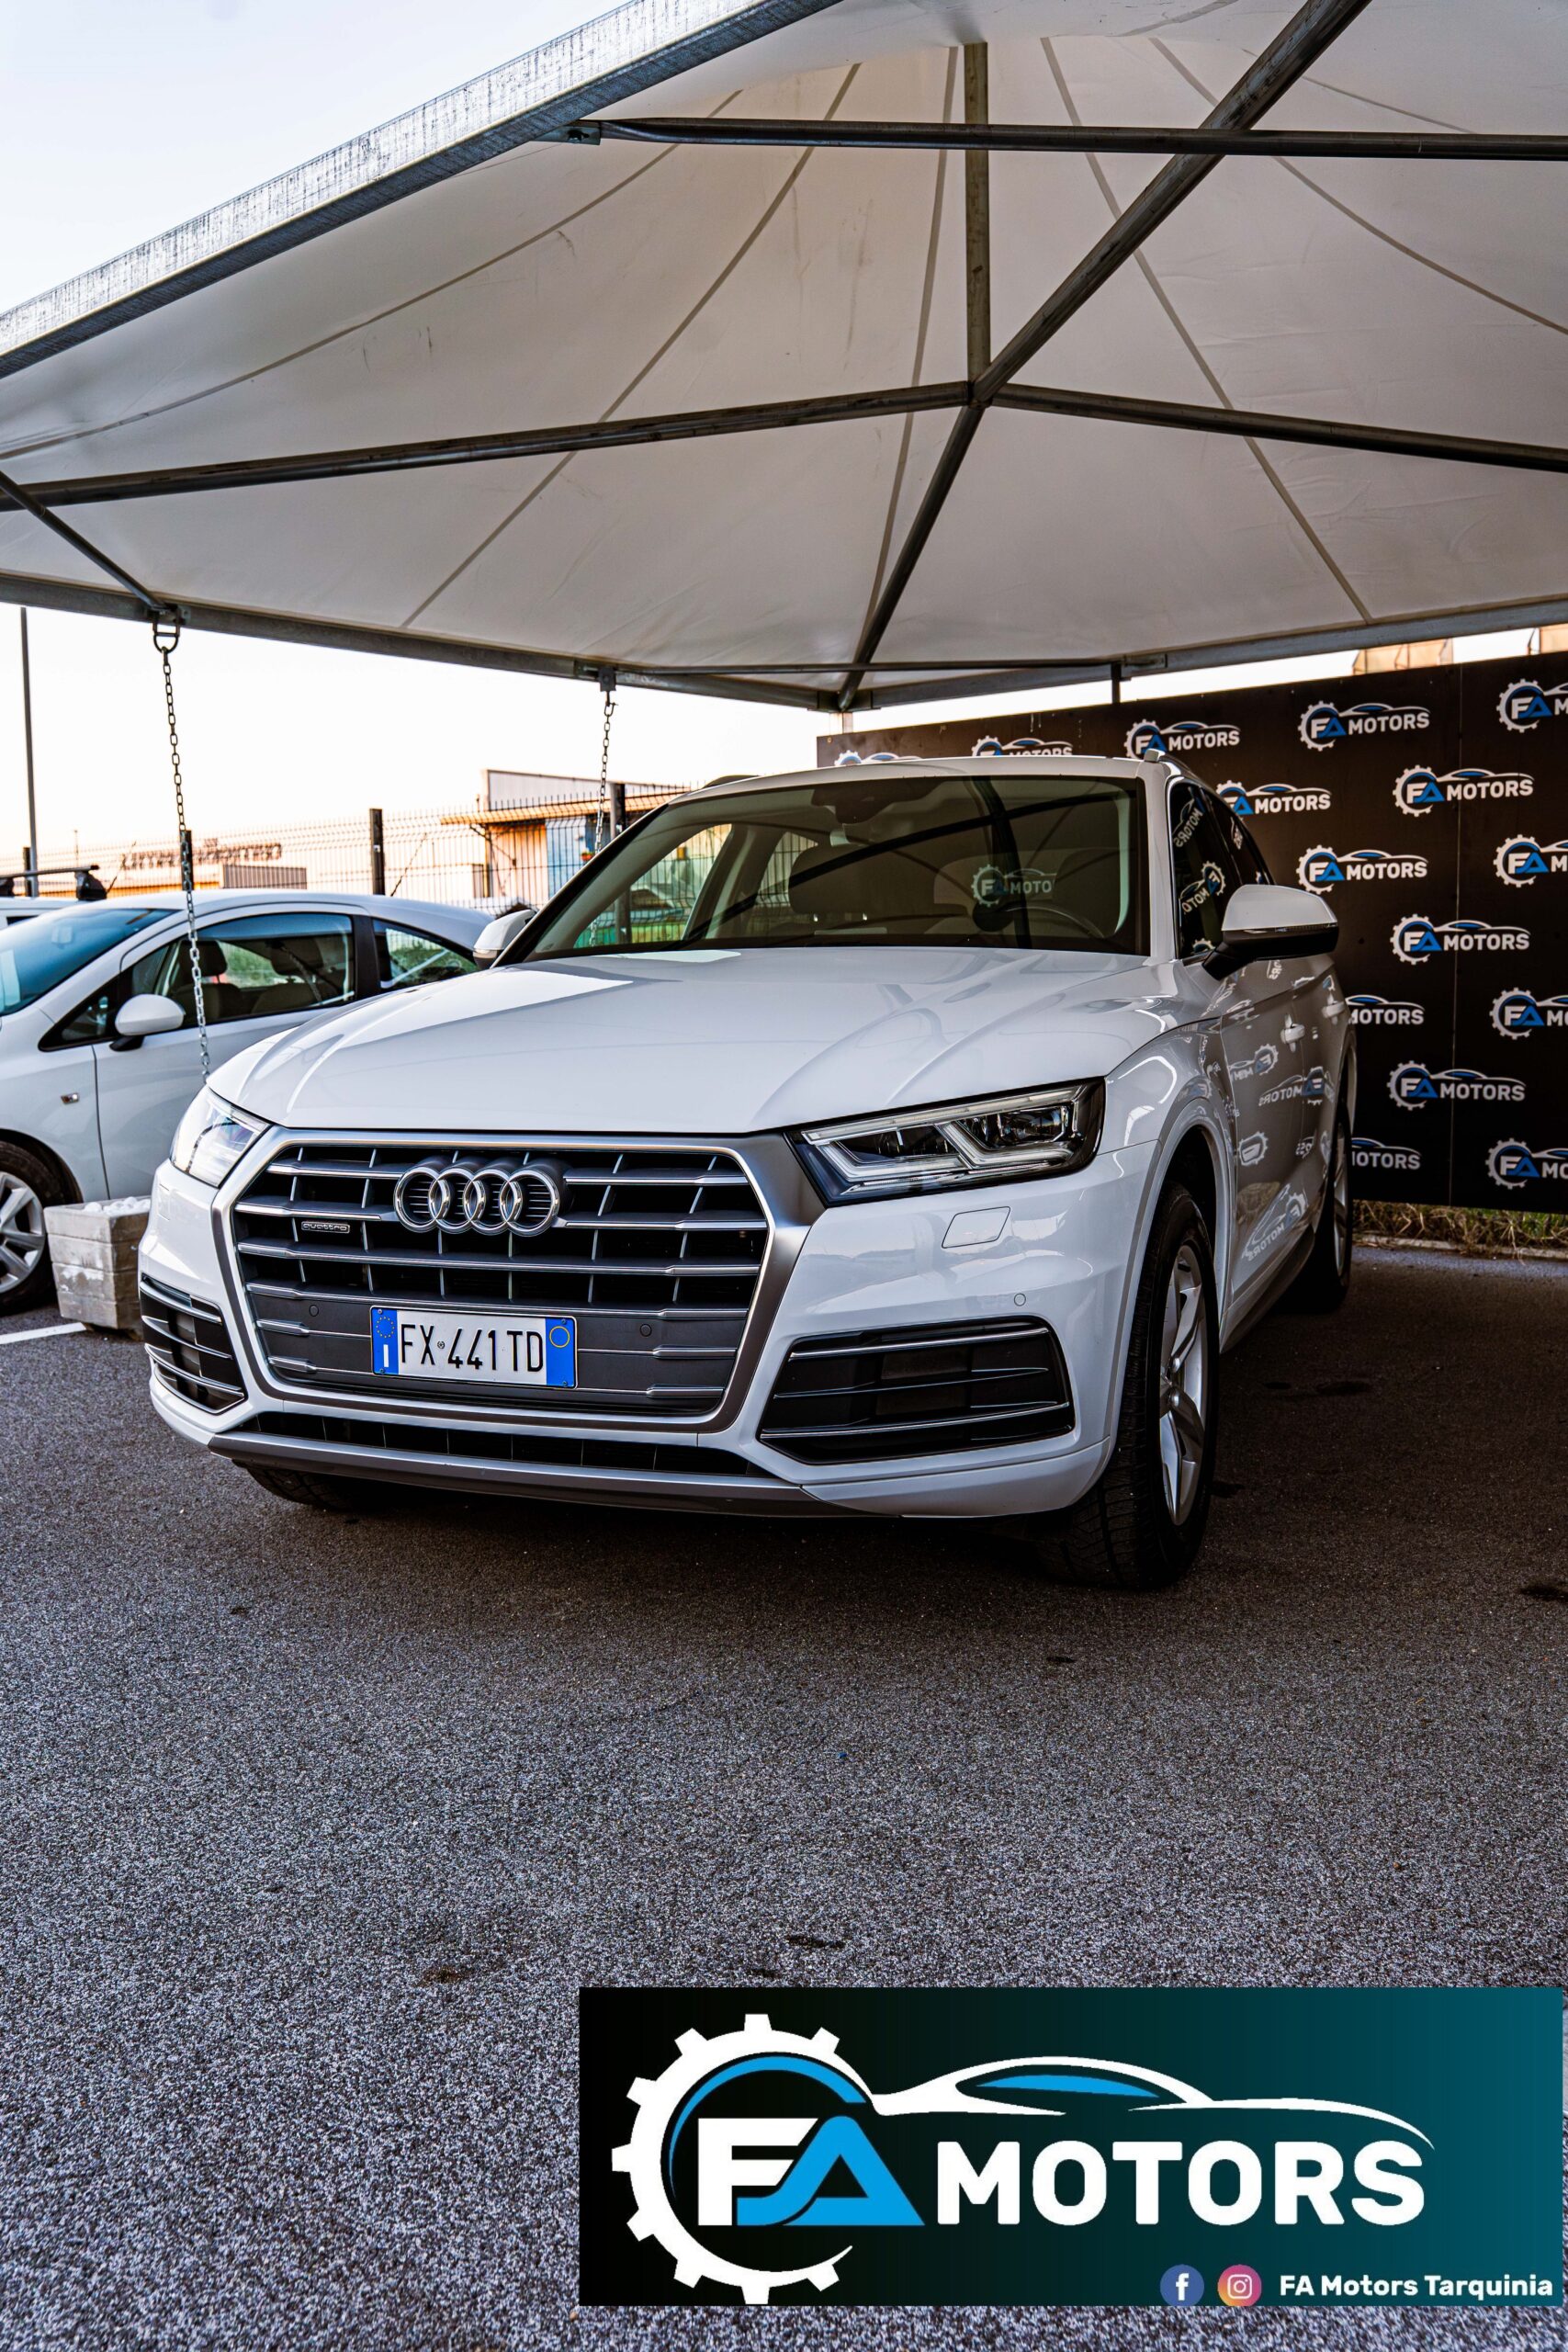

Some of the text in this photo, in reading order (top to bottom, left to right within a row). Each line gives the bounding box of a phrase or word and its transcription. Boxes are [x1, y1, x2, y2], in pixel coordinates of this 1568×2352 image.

[1511, 695, 1552, 719] FA
[1311, 712, 1429, 739] FA MOTORS
[1168, 730, 1240, 752] MOTORS
[1406, 779, 1534, 804] FA MOTORS
[1255, 794, 1331, 815] MOTORS
[1309, 861, 1427, 882] FA MOTORS
[1507, 852, 1549, 874] FA
[1404, 931, 1530, 952] FA MOTORS
[1504, 1005, 1545, 1026] FA
[1401, 1078, 1526, 1102] FA MOTORS
[1351, 1150, 1421, 1170] OTORS
[1500, 1155, 1540, 1177] FA
[302, 1223, 348, 1232] quattro
